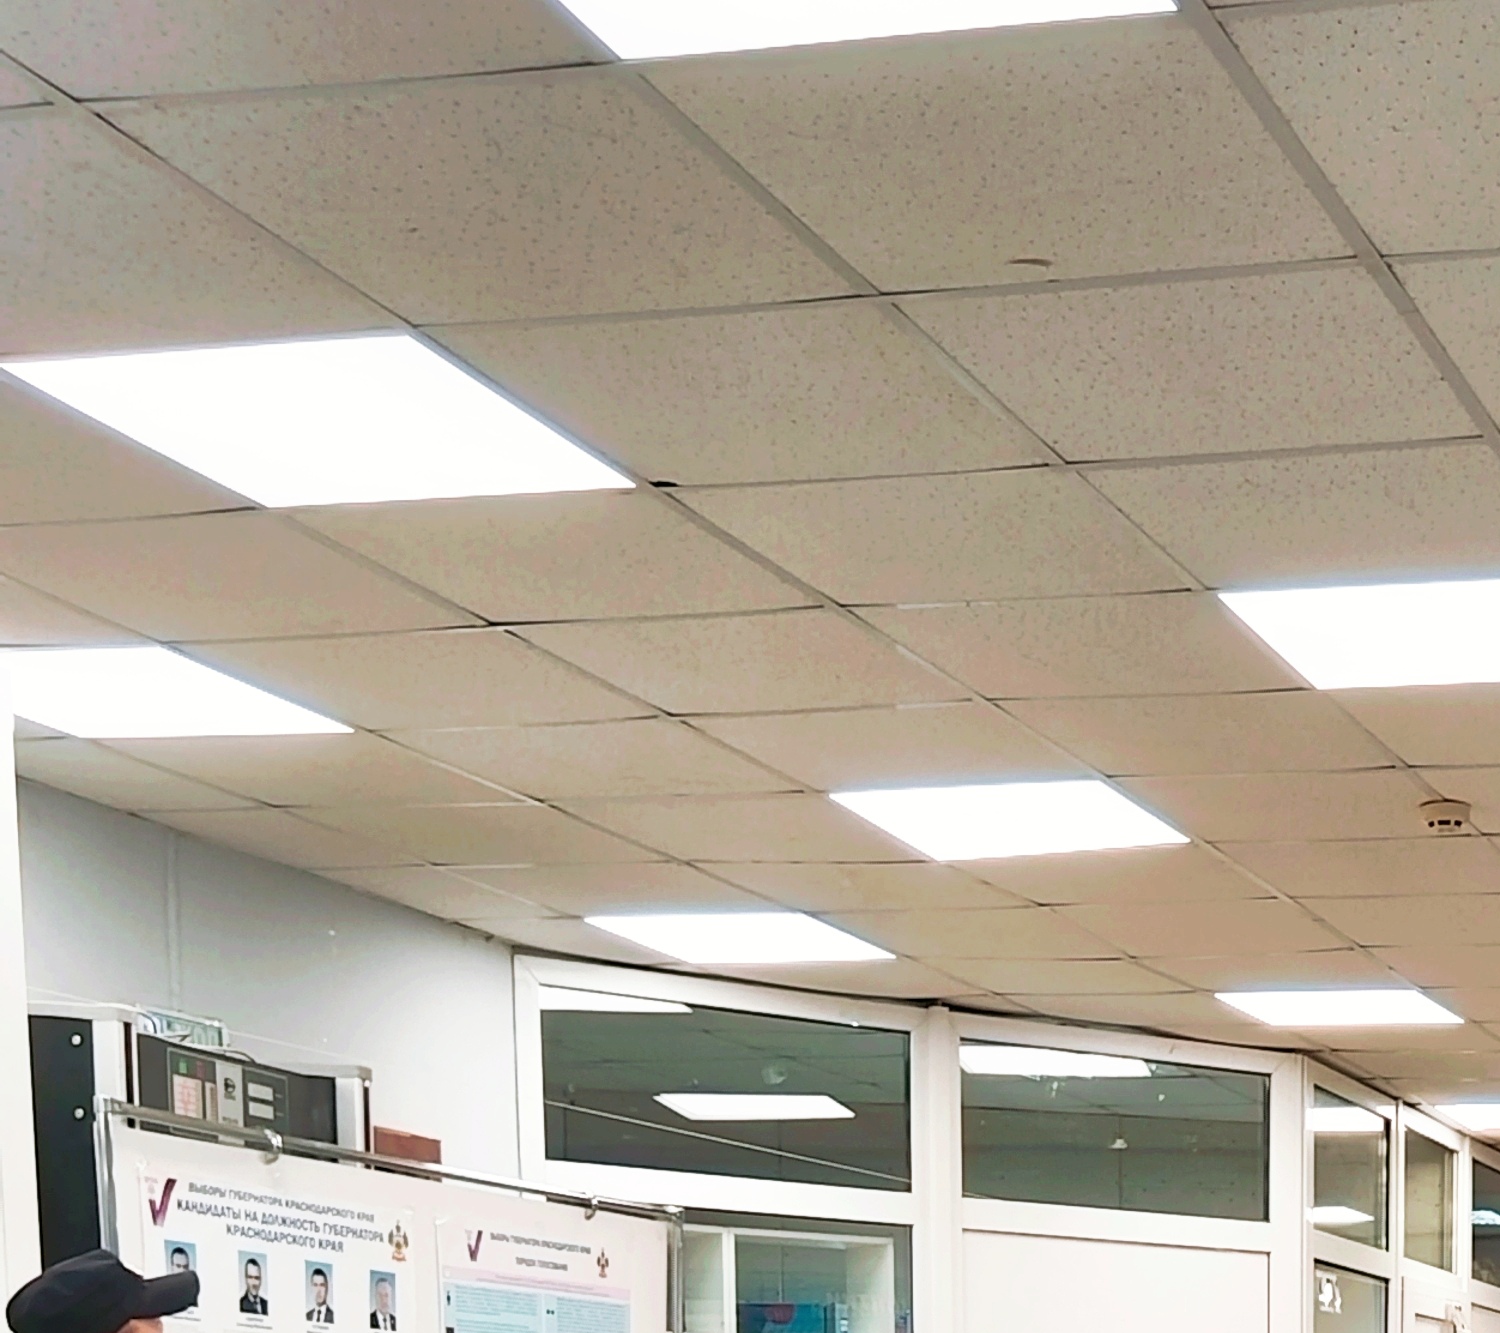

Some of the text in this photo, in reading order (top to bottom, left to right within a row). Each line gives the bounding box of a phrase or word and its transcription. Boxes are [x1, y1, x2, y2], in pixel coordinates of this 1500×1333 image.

[177, 1199, 384, 1243] КАНДИДАТЫ НА ДОЛЖНОСТЬ ГУБЕРНАТОРА
[188, 1182, 375, 1223] ВЫБОРЫ ГУБЕРНАТОРА КРАСНОДАРСКОГО КРАЯ
[226, 1224, 344, 1252] КРАСНОДАРСКОГО КРАЯ
